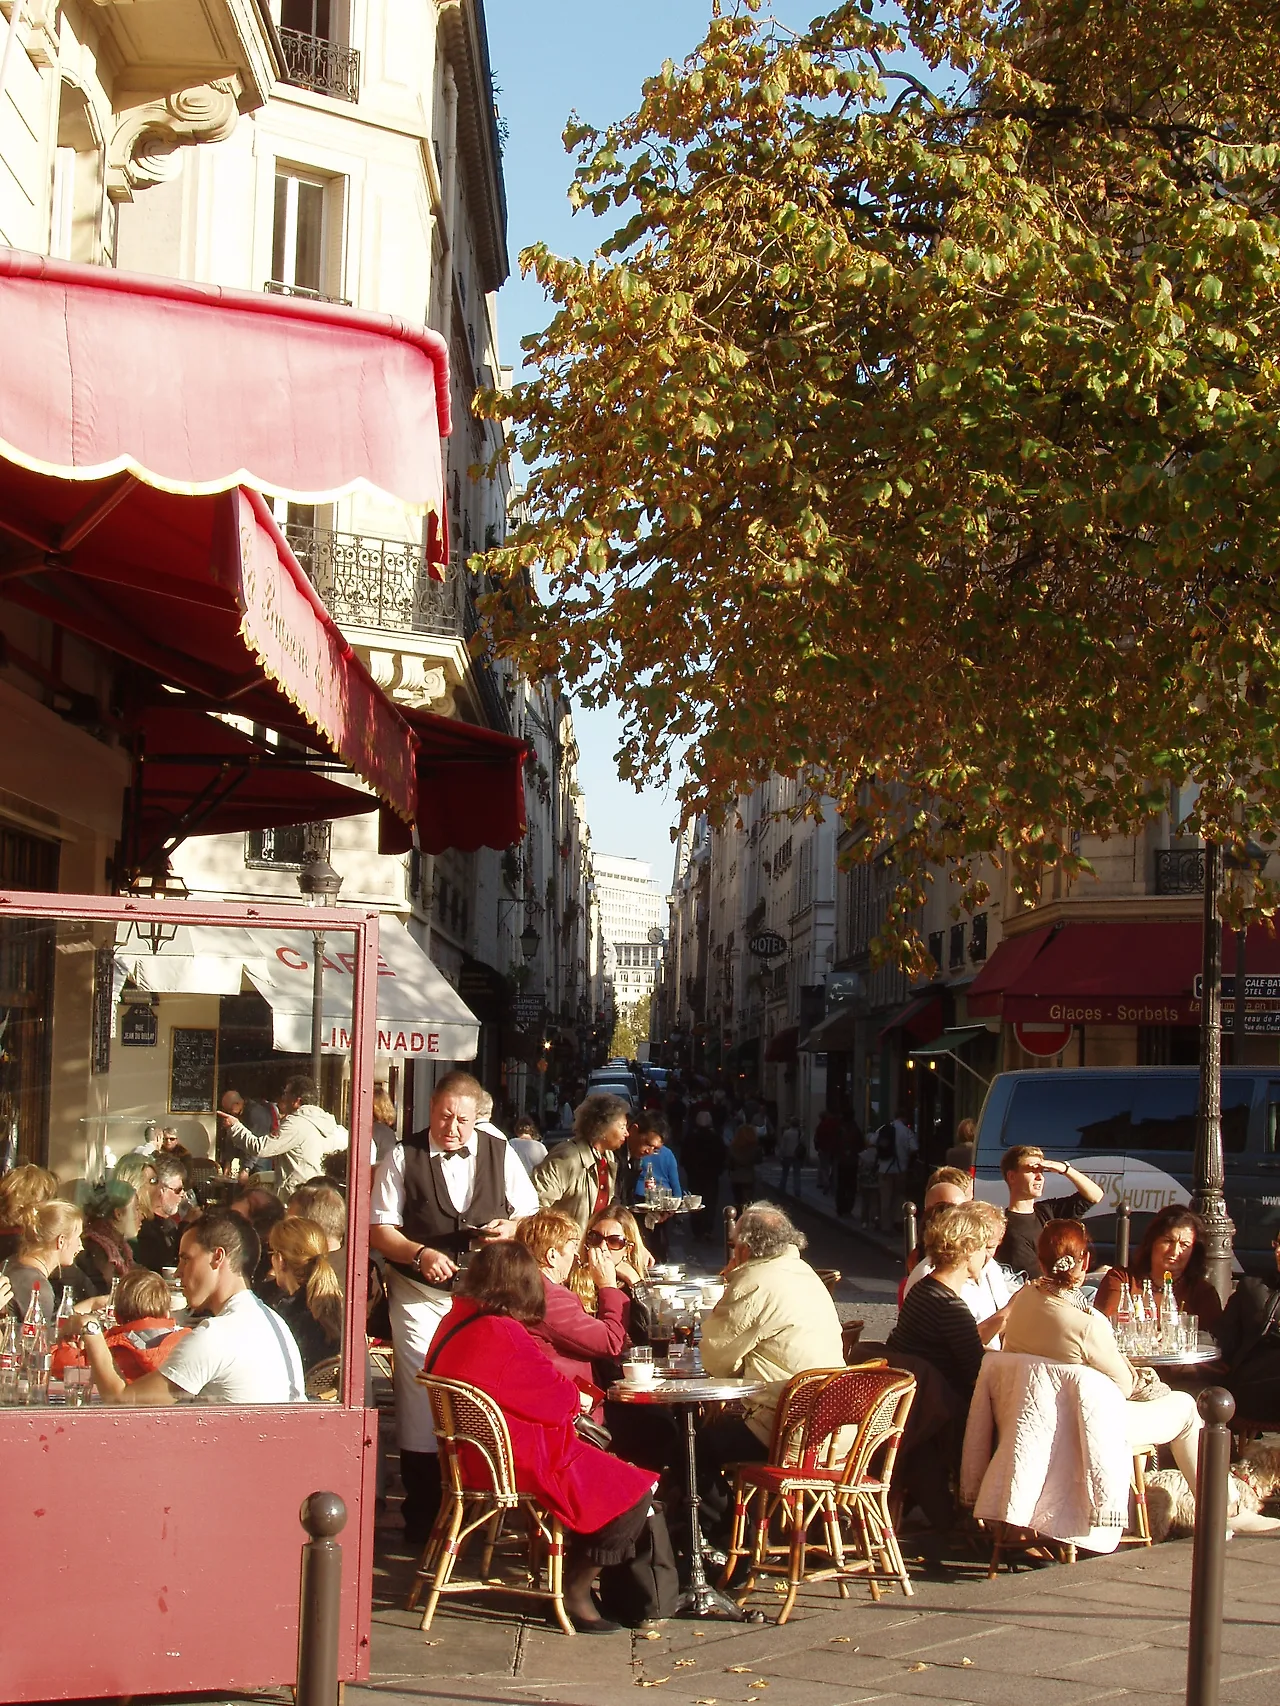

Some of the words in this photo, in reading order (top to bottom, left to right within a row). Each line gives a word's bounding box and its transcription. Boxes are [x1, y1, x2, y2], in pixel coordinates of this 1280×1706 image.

[751, 938, 784, 953] HOTEL
[1050, 1004, 1102, 1020] Glaces
[1117, 1005, 1179, 1021] Sorbets
[321, 1028, 440, 1053] LIMNADE
